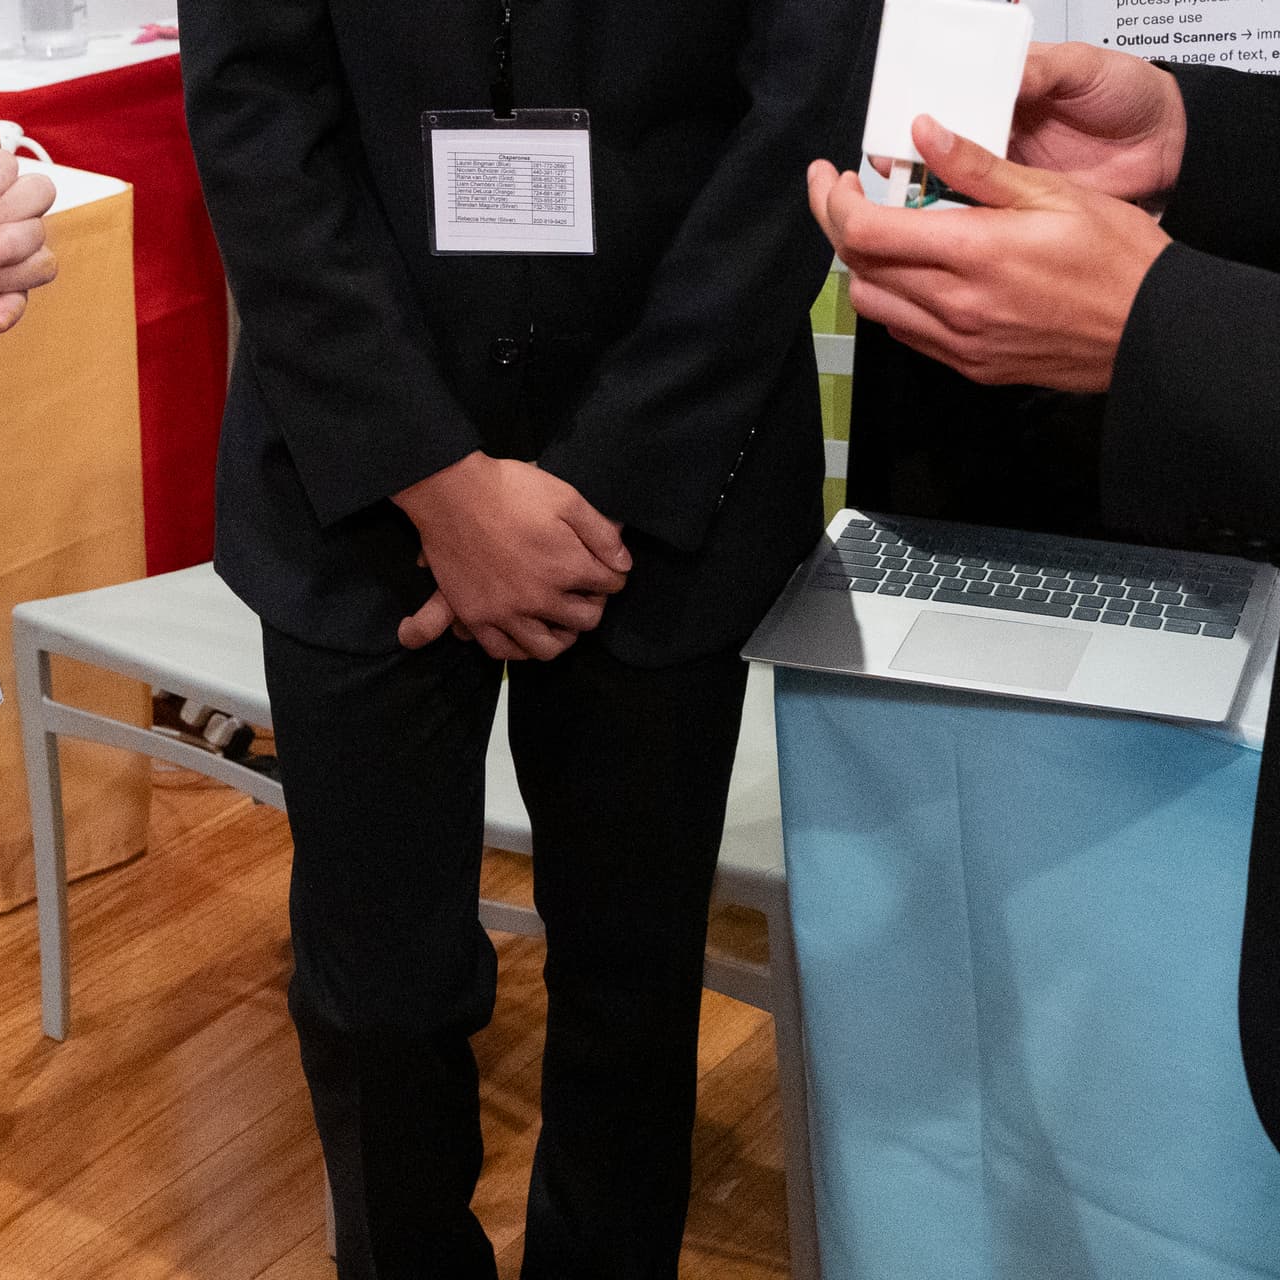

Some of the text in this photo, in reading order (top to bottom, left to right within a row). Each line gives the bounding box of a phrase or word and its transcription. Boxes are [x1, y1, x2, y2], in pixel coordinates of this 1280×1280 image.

[1116, 13, 1202, 29] per case use
[1116, 32, 1169, 46] Outloud
[1172, 32, 1237, 44] Scanners
[1238, 49, 1267, 61] text,
